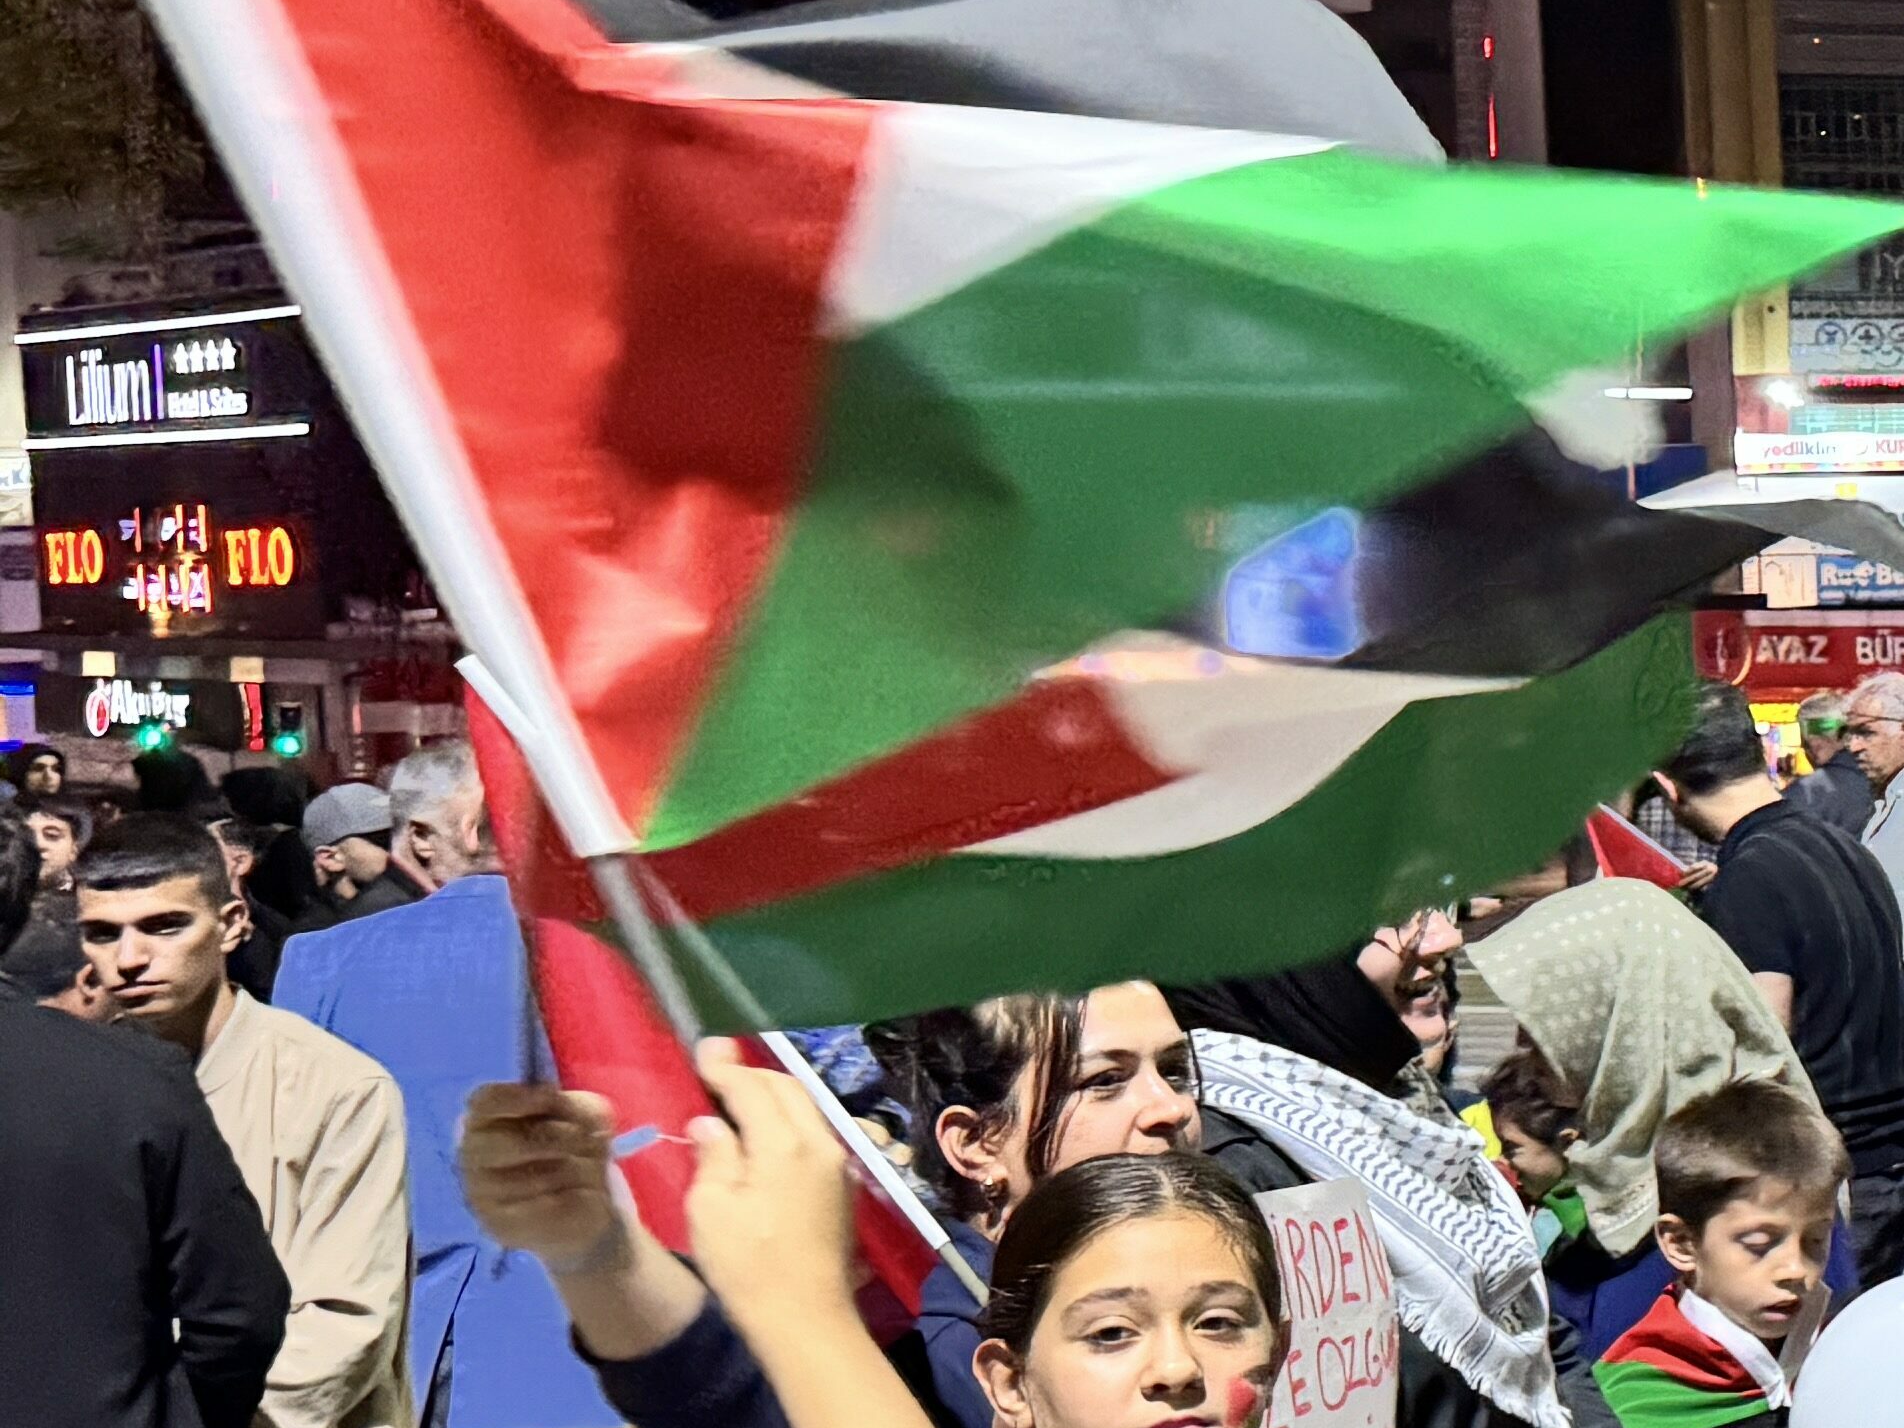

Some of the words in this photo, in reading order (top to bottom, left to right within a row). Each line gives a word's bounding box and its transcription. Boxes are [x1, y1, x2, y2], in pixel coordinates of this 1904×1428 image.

[65, 348, 151, 426] Lilium
[45, 529, 105, 585] FLO
[225, 527, 294, 586] FLO
[1755, 634, 1829, 664] AYAZ
